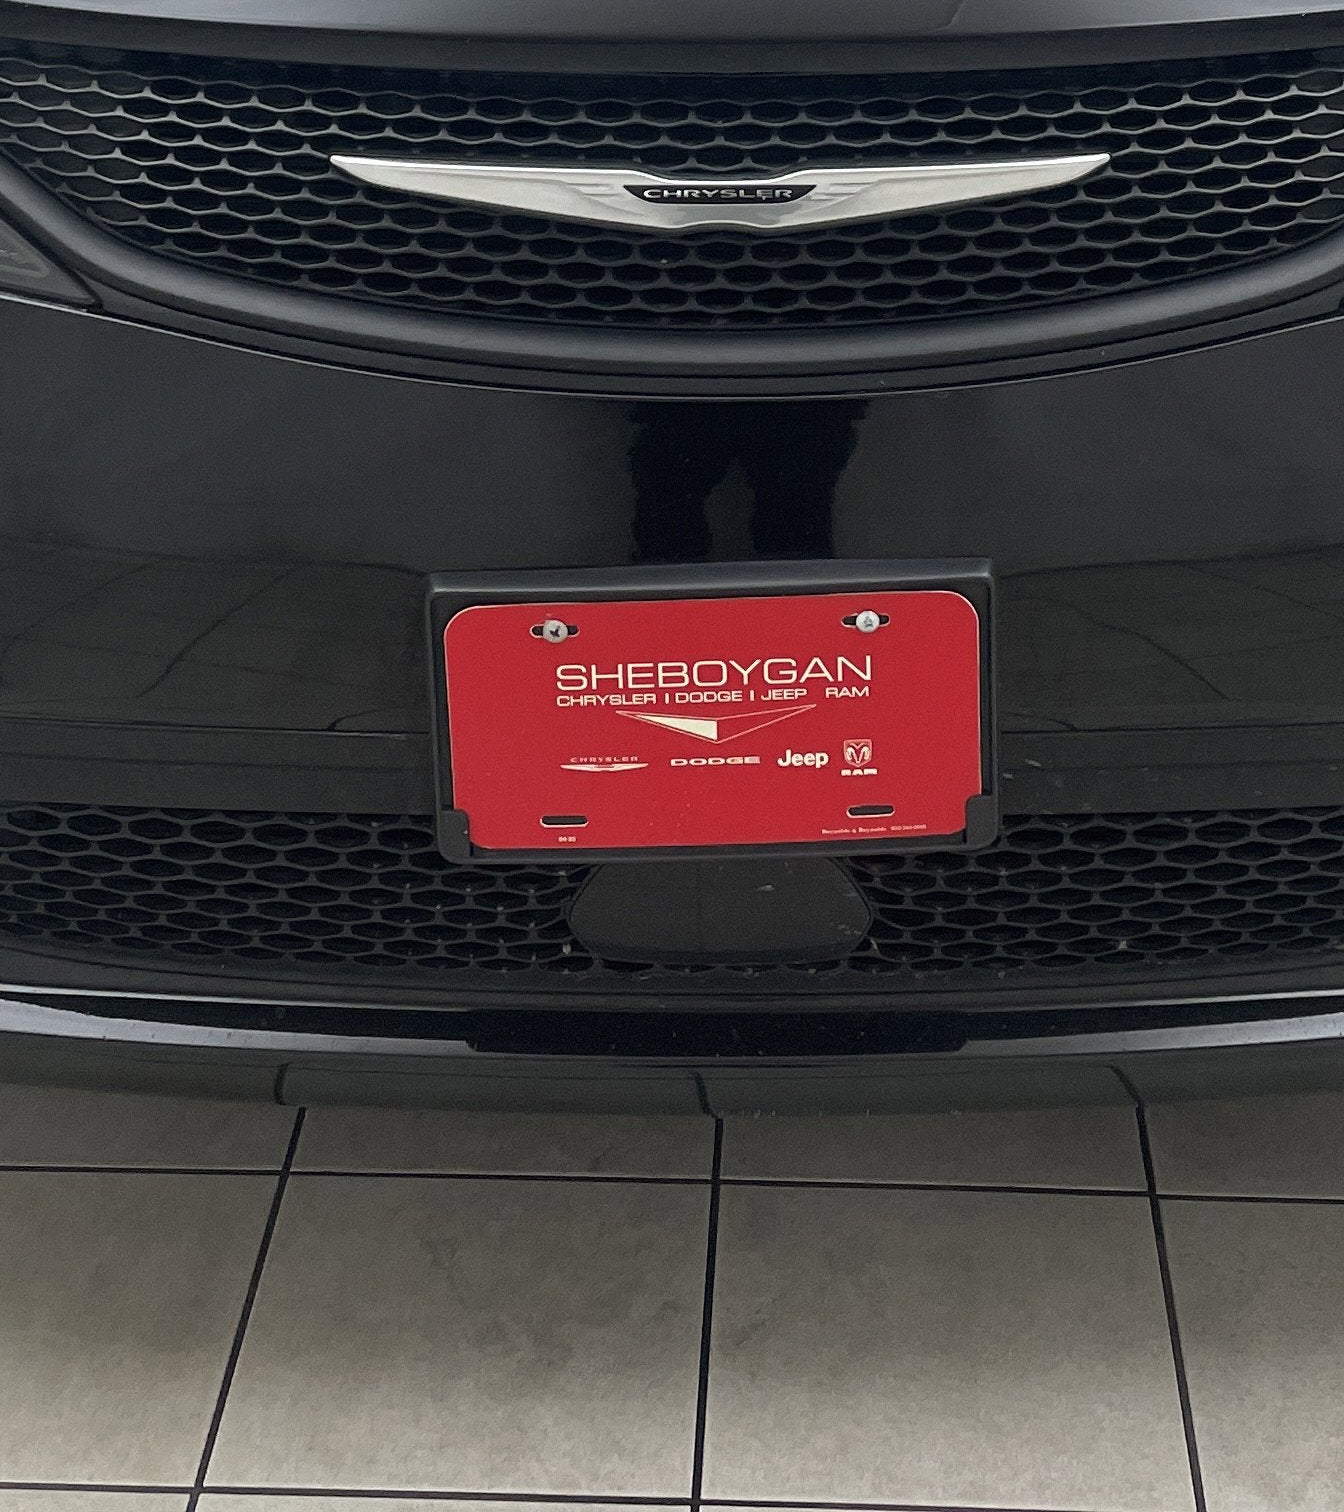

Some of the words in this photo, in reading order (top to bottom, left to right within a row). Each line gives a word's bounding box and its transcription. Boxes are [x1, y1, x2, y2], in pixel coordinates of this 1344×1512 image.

[643, 189, 794, 200] CHRYSLER
[556, 654, 872, 691] SHEBOYGAN
[556, 692, 657, 707] CHRYSLER
[675, 690, 743, 704] DODGE
[761, 688, 808, 701] JEEP
[825, 685, 870, 699] RAM
[670, 755, 761, 767] DODGE
[777, 749, 829, 769] Jeep
[840, 768, 878, 777] RAM
